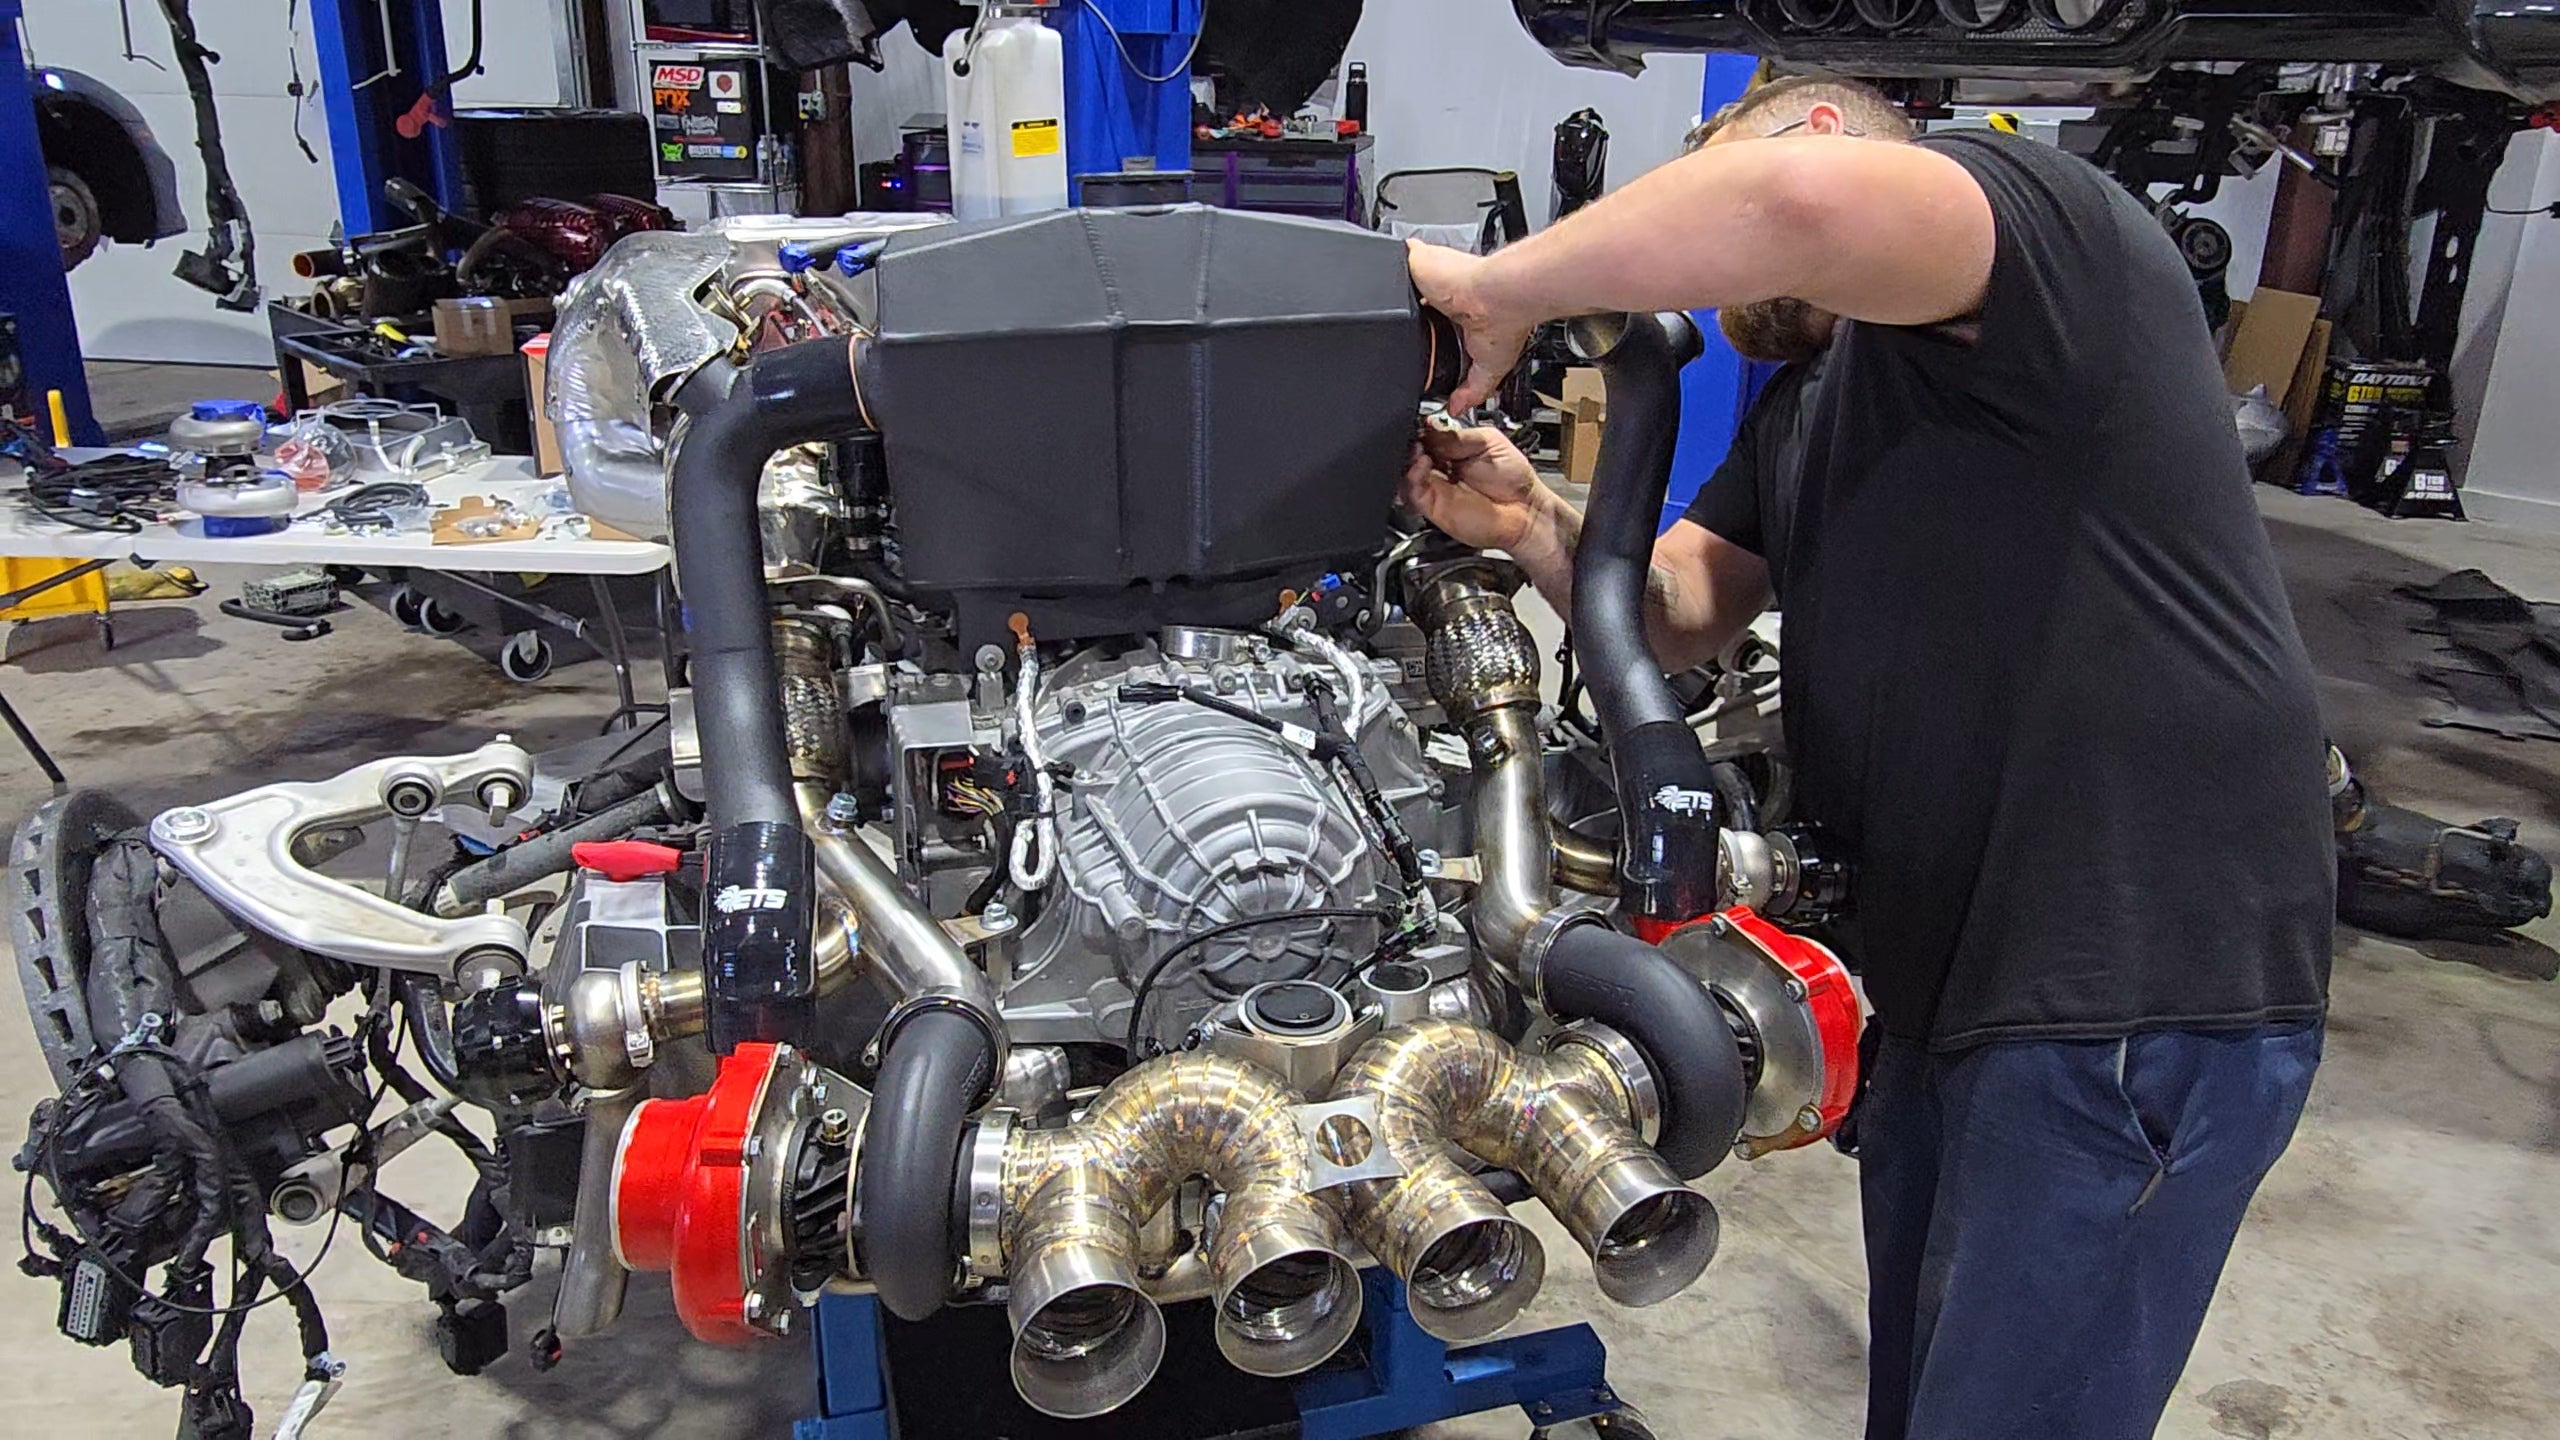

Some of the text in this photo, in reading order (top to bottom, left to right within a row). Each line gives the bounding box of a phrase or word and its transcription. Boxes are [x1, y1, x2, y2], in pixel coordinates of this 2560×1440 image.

[657, 67, 700, 82] MSD
[654, 90, 691, 111] FOX
[2350, 373, 2432, 386] DAYTONA
[2347, 385, 2361, 403] 6
[2360, 386, 2383, 400] TON
[1673, 789, 1713, 811] ETS
[732, 887, 788, 911] ETS
